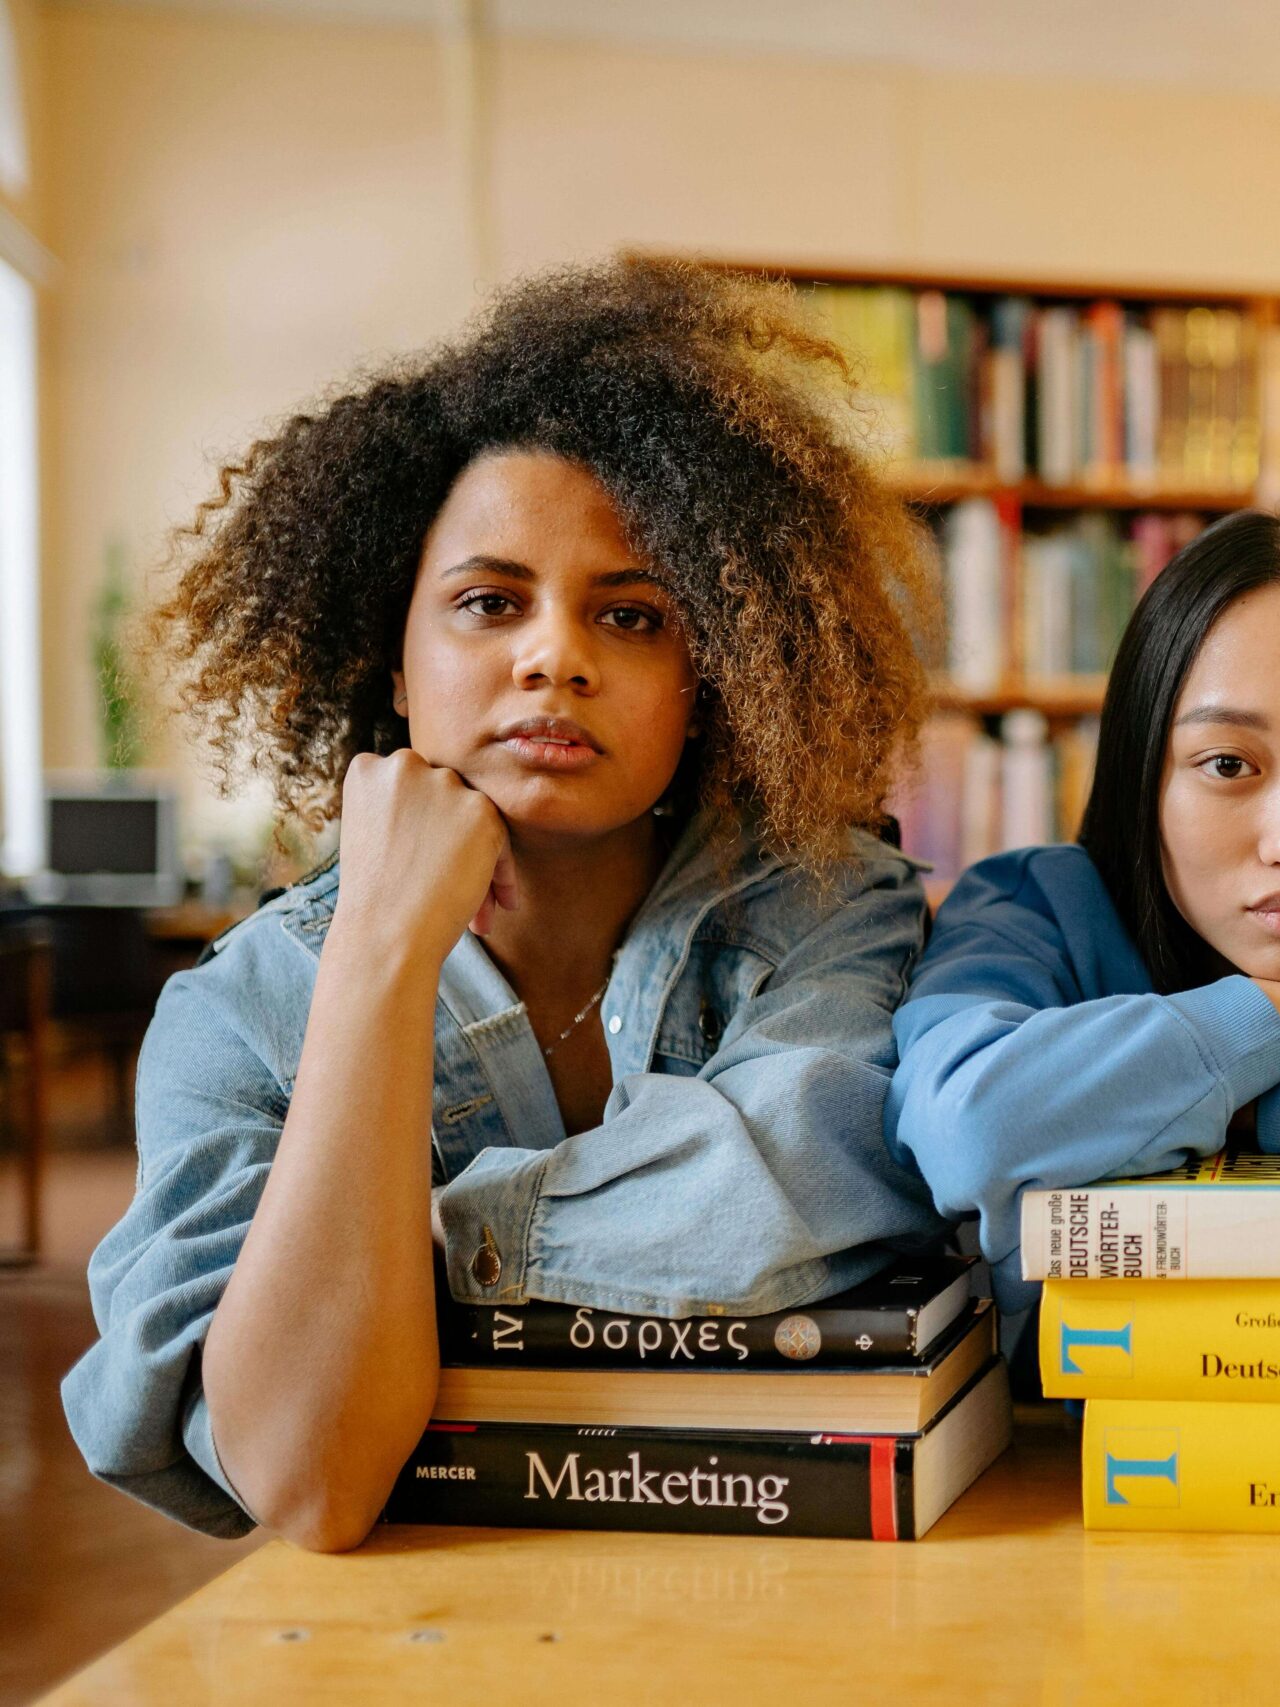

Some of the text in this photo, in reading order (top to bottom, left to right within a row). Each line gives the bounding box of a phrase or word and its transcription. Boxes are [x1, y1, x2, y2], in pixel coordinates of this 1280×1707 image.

[1048, 1194, 1065, 1279] Das neue große
[1070, 1194, 1089, 1279] DEUTSCHE
[1095, 1202, 1119, 1279] WÖRTER-
[1124, 1235, 1142, 1279] BUCH
[1170, 1248, 1180, 1270] BUCH
[416, 1451, 789, 1525] MERCER Marketing
